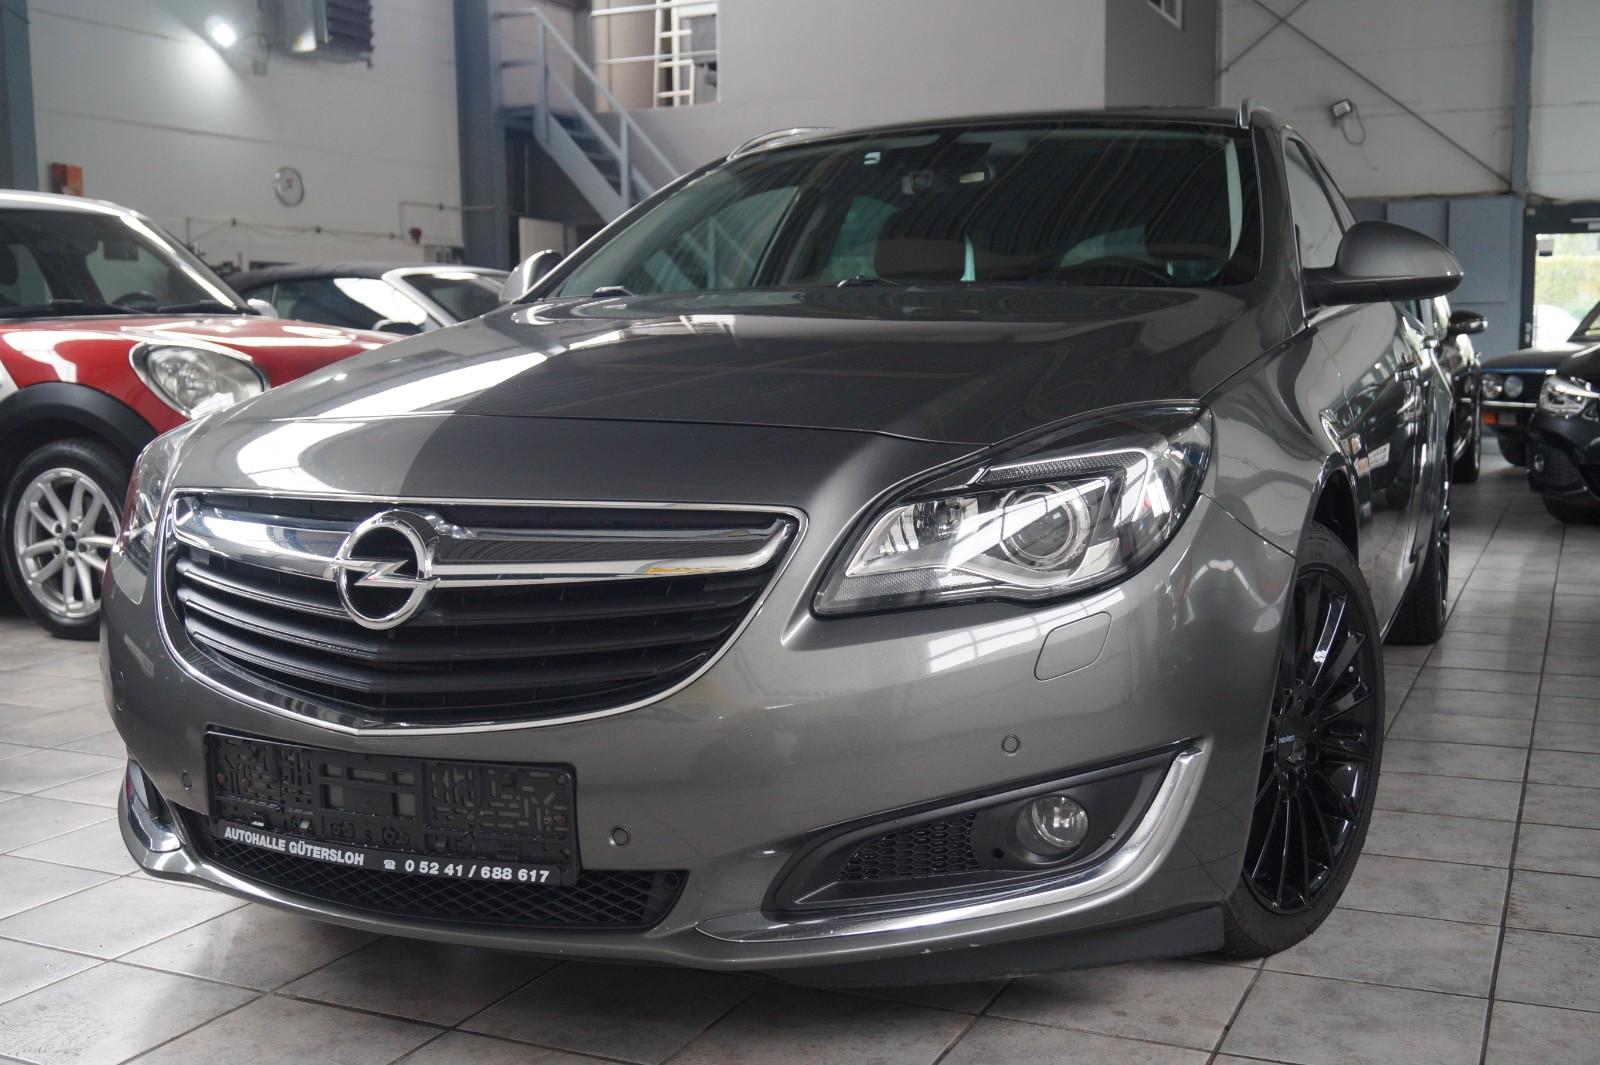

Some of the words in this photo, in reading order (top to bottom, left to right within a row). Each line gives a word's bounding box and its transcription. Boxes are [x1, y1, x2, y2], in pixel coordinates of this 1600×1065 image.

[224, 826, 287, 852] AUTOHALLE
[288, 840, 365, 866] GÜTERSLOH
[404, 859, 415, 872] 0
[418, 861, 439, 875] 52
[443, 863, 464, 877] 41
[467, 865, 477, 878] /
[480, 866, 513, 880] 688
[517, 868, 550, 883] 617
